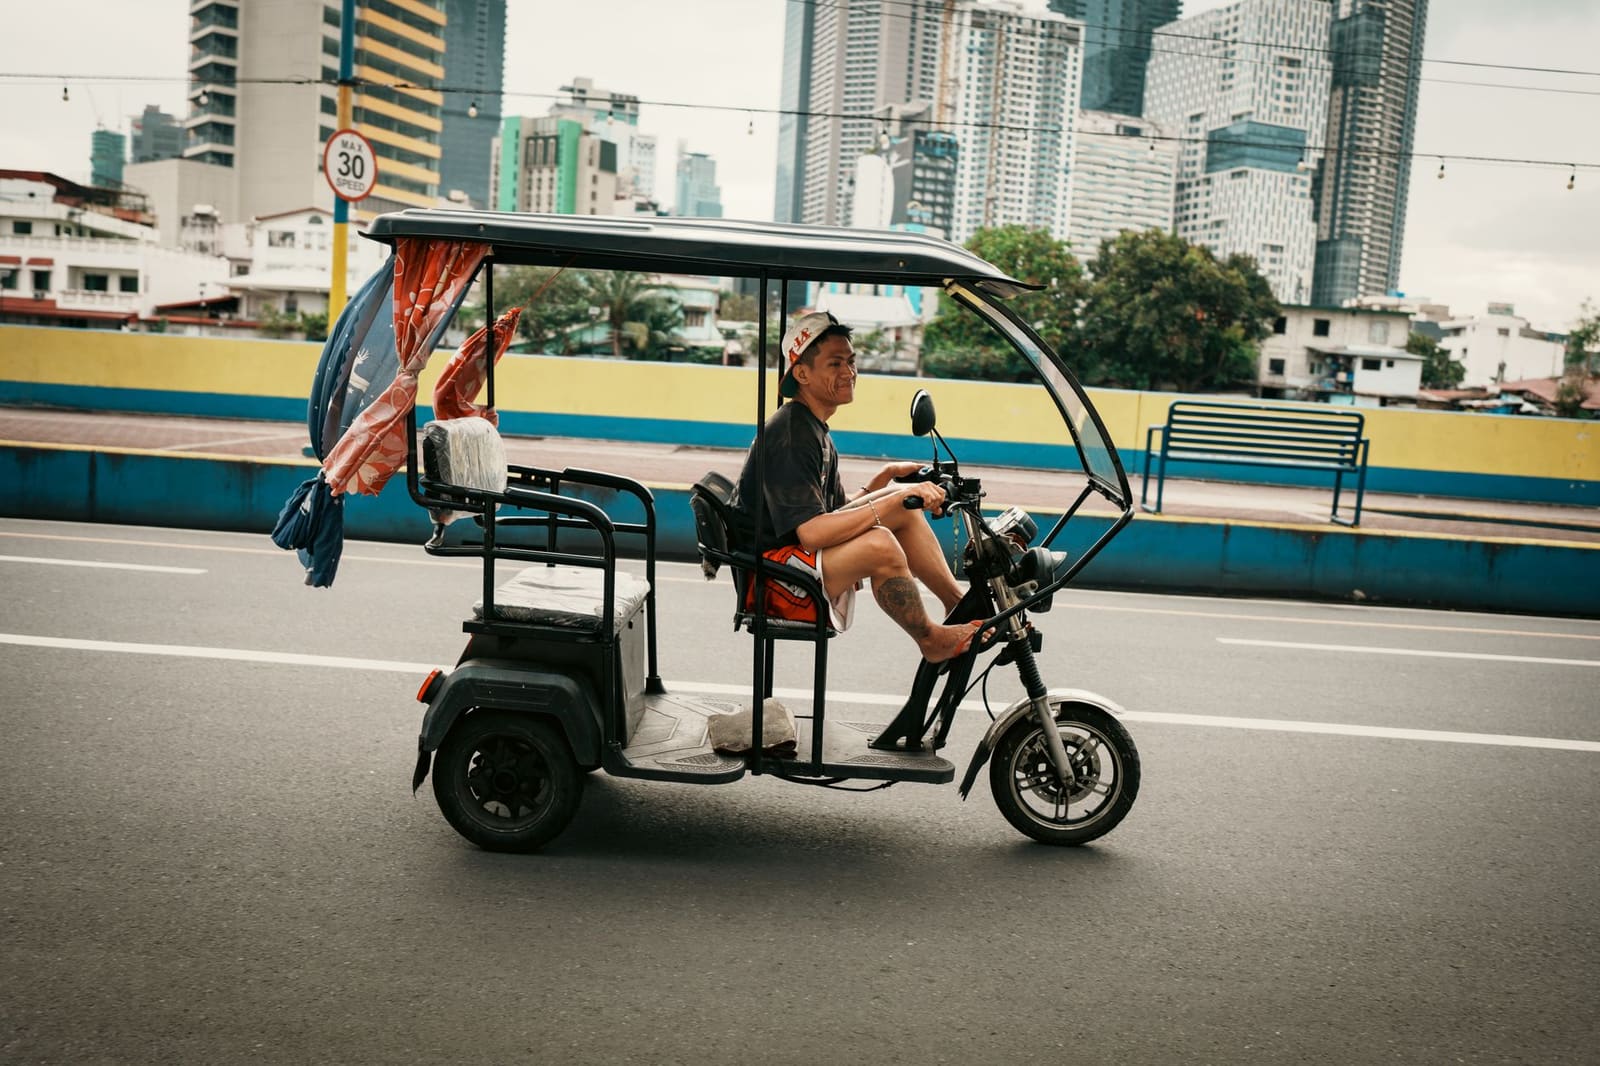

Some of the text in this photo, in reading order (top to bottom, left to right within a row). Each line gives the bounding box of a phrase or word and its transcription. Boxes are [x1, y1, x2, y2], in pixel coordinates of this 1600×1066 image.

[341, 139, 363, 152] MAX
[337, 151, 365, 179] 30
[336, 178, 365, 191] SPEED
